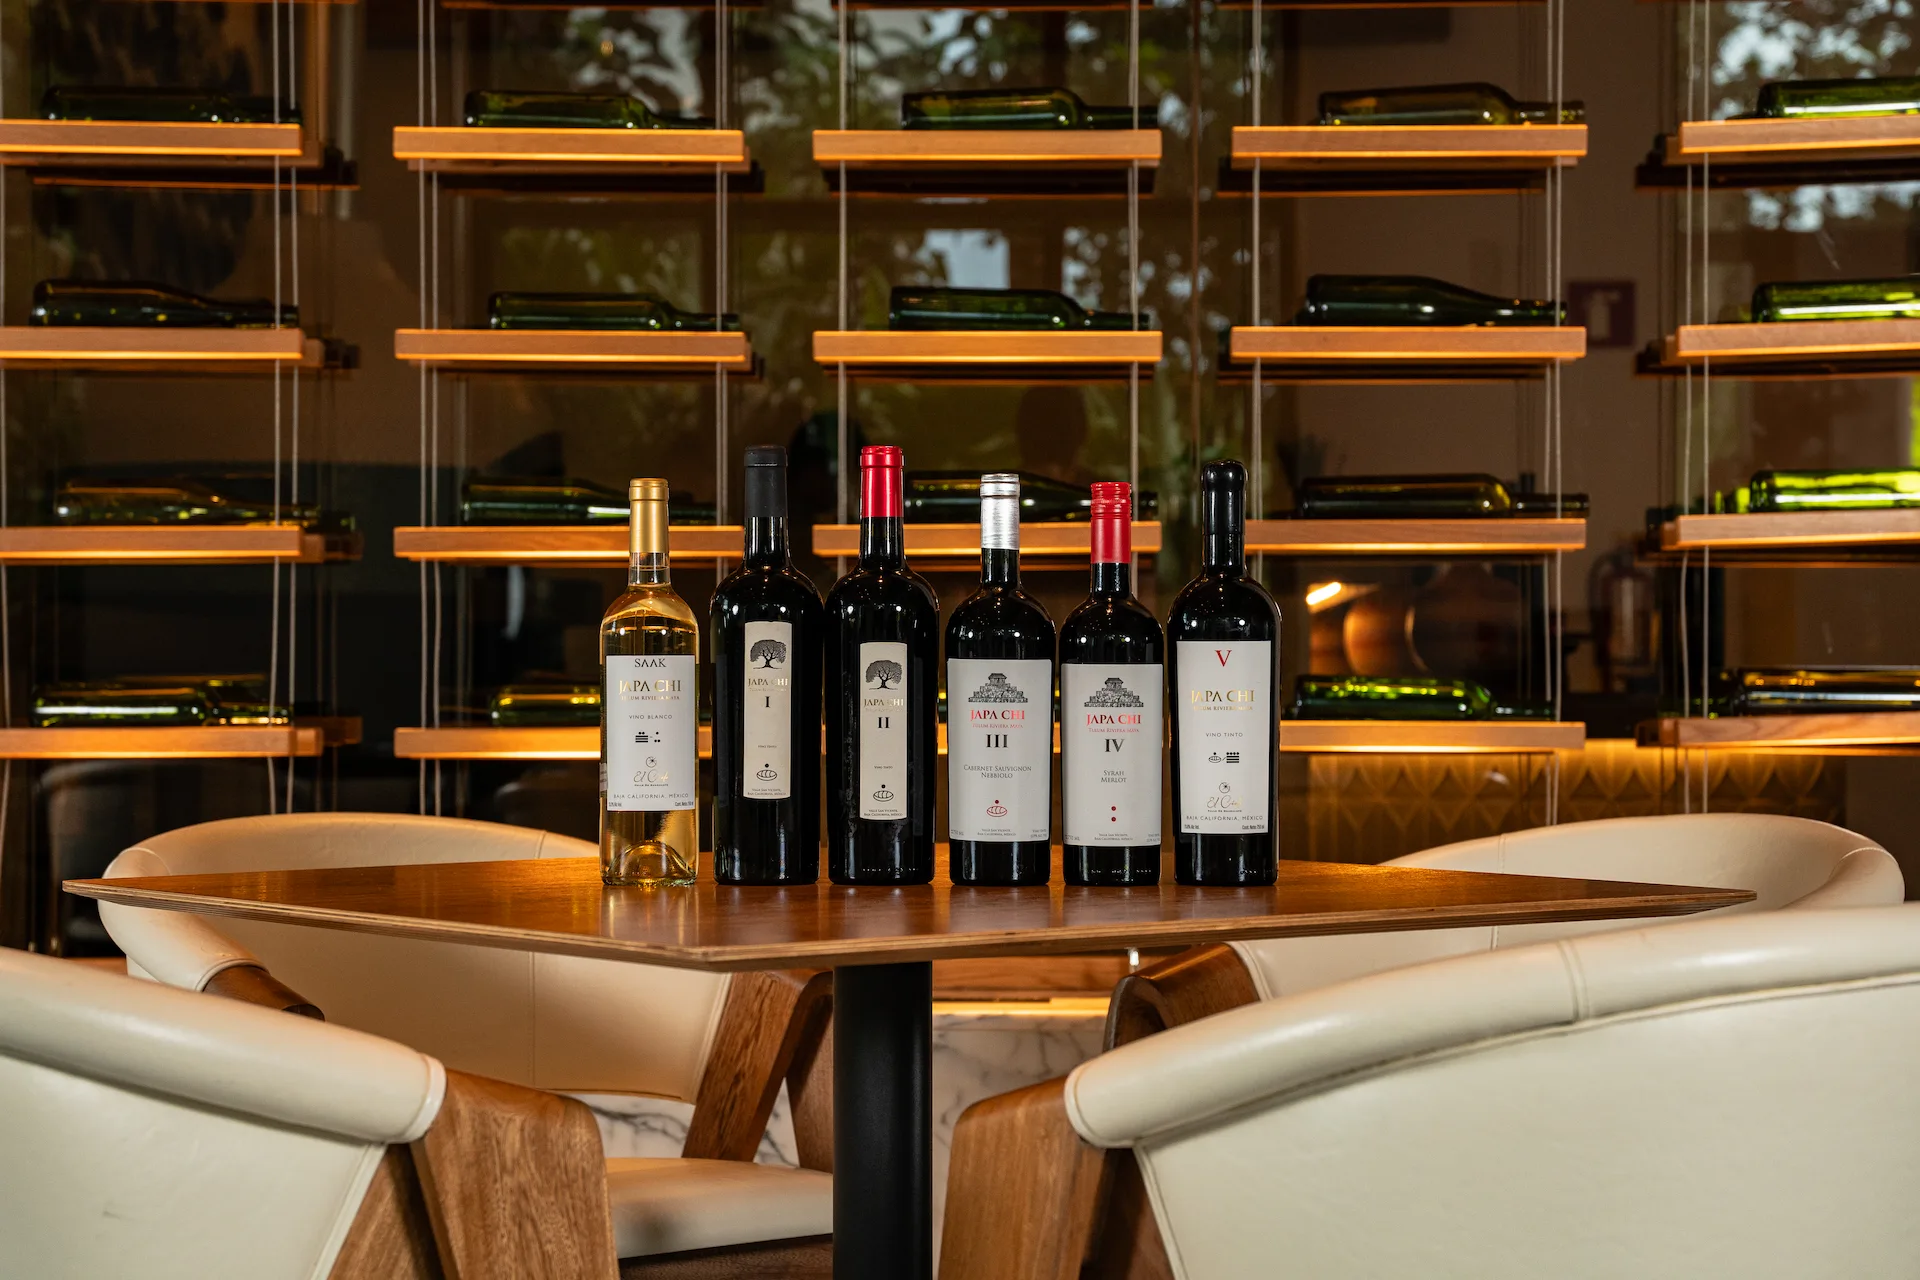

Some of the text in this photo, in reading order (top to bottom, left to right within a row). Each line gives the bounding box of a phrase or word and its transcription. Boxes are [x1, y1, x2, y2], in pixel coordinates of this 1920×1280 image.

[634, 658, 667, 668] SAAK
[1214, 650, 1232, 667] V
[619, 680, 681, 695] JAPA CHI
[748, 678, 769, 687] JAPA
[765, 696, 771, 708] I
[864, 699, 885, 707] JAPA
[1191, 690, 1254, 704] JAPA CHI
[970, 710, 1025, 721] JAPA CHI
[1086, 714, 1141, 726] JAPA CHI
[877, 717, 890, 729] II
[986, 734, 1008, 748] III
[1104, 738, 1125, 753] IV
